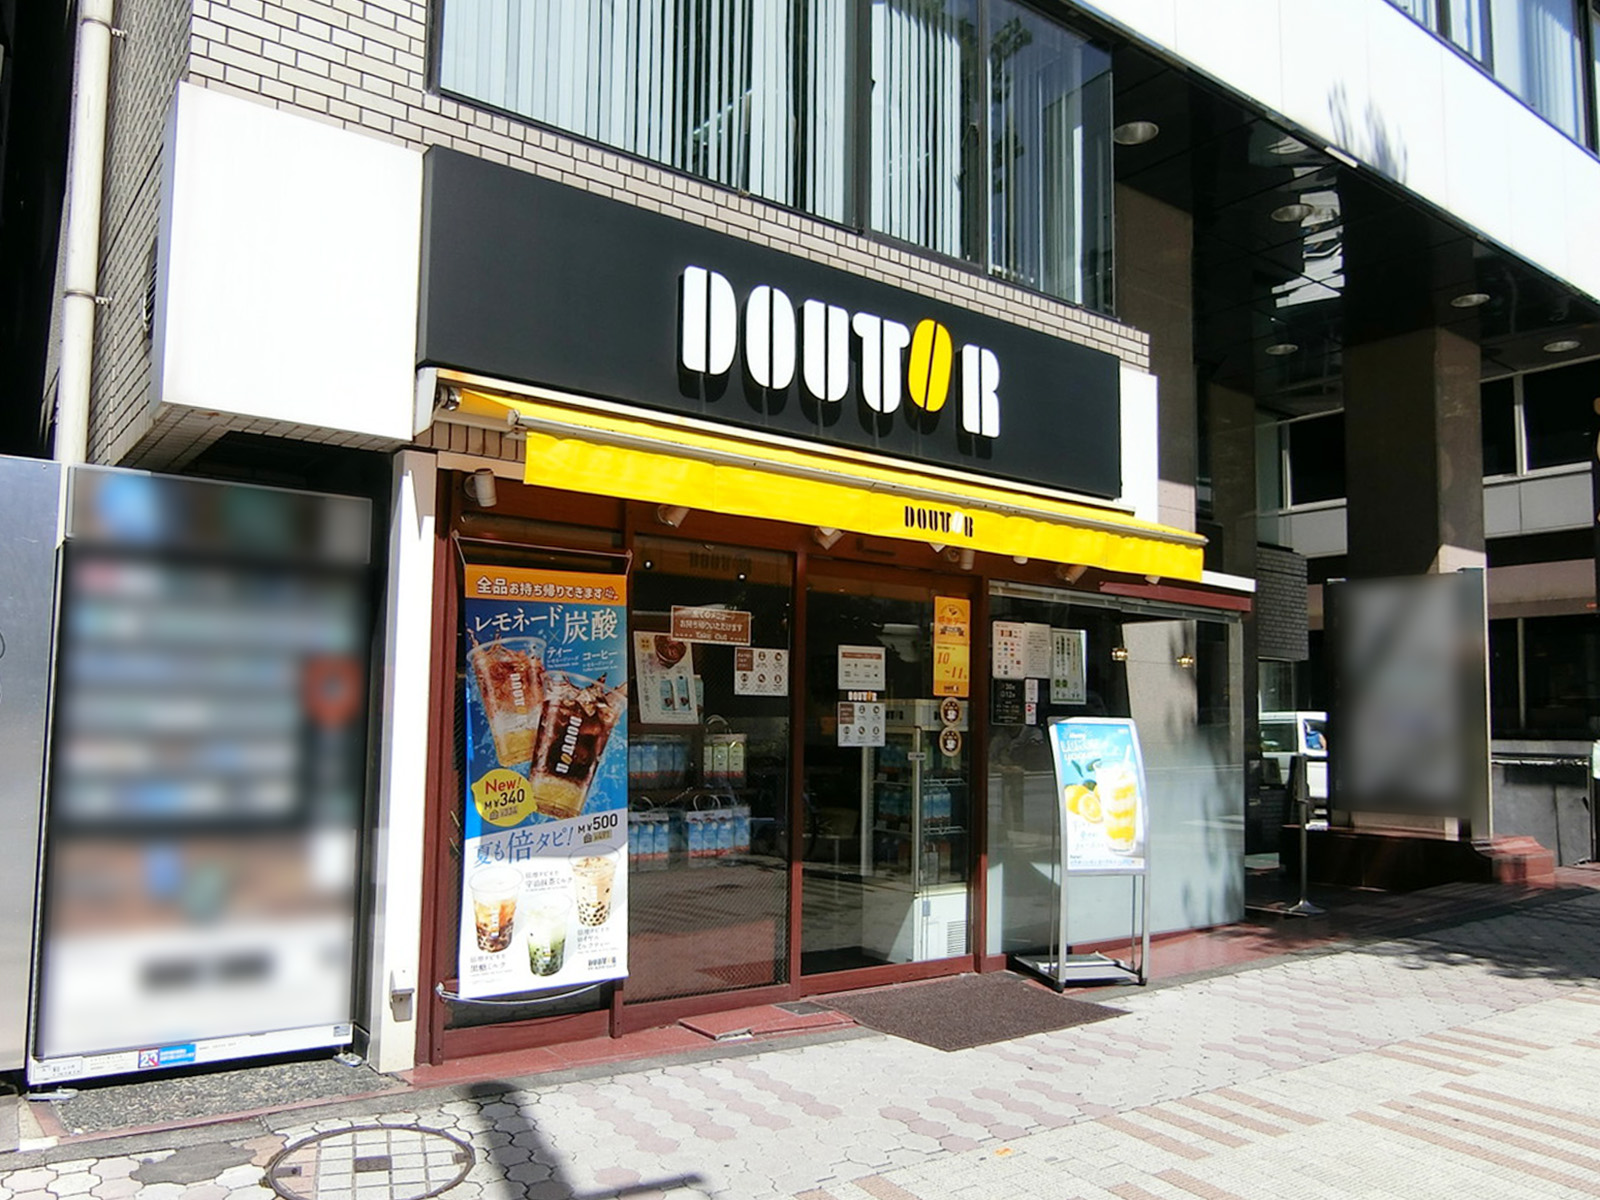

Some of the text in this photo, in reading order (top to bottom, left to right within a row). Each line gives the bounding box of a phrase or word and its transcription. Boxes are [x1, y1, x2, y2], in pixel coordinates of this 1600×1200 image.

[682, 265, 1000, 439] DOUTOR
[904, 505, 974, 538] DOUTOR
[476, 575, 602, 599] 全品お持ち帰りできます
[475, 604, 563, 632] レモネード
[562, 609, 618, 645] 炭酸
[582, 649, 618, 661] コーヒー
[555, 715, 582, 774] DOUTOR
[485, 777, 522, 795] New!
